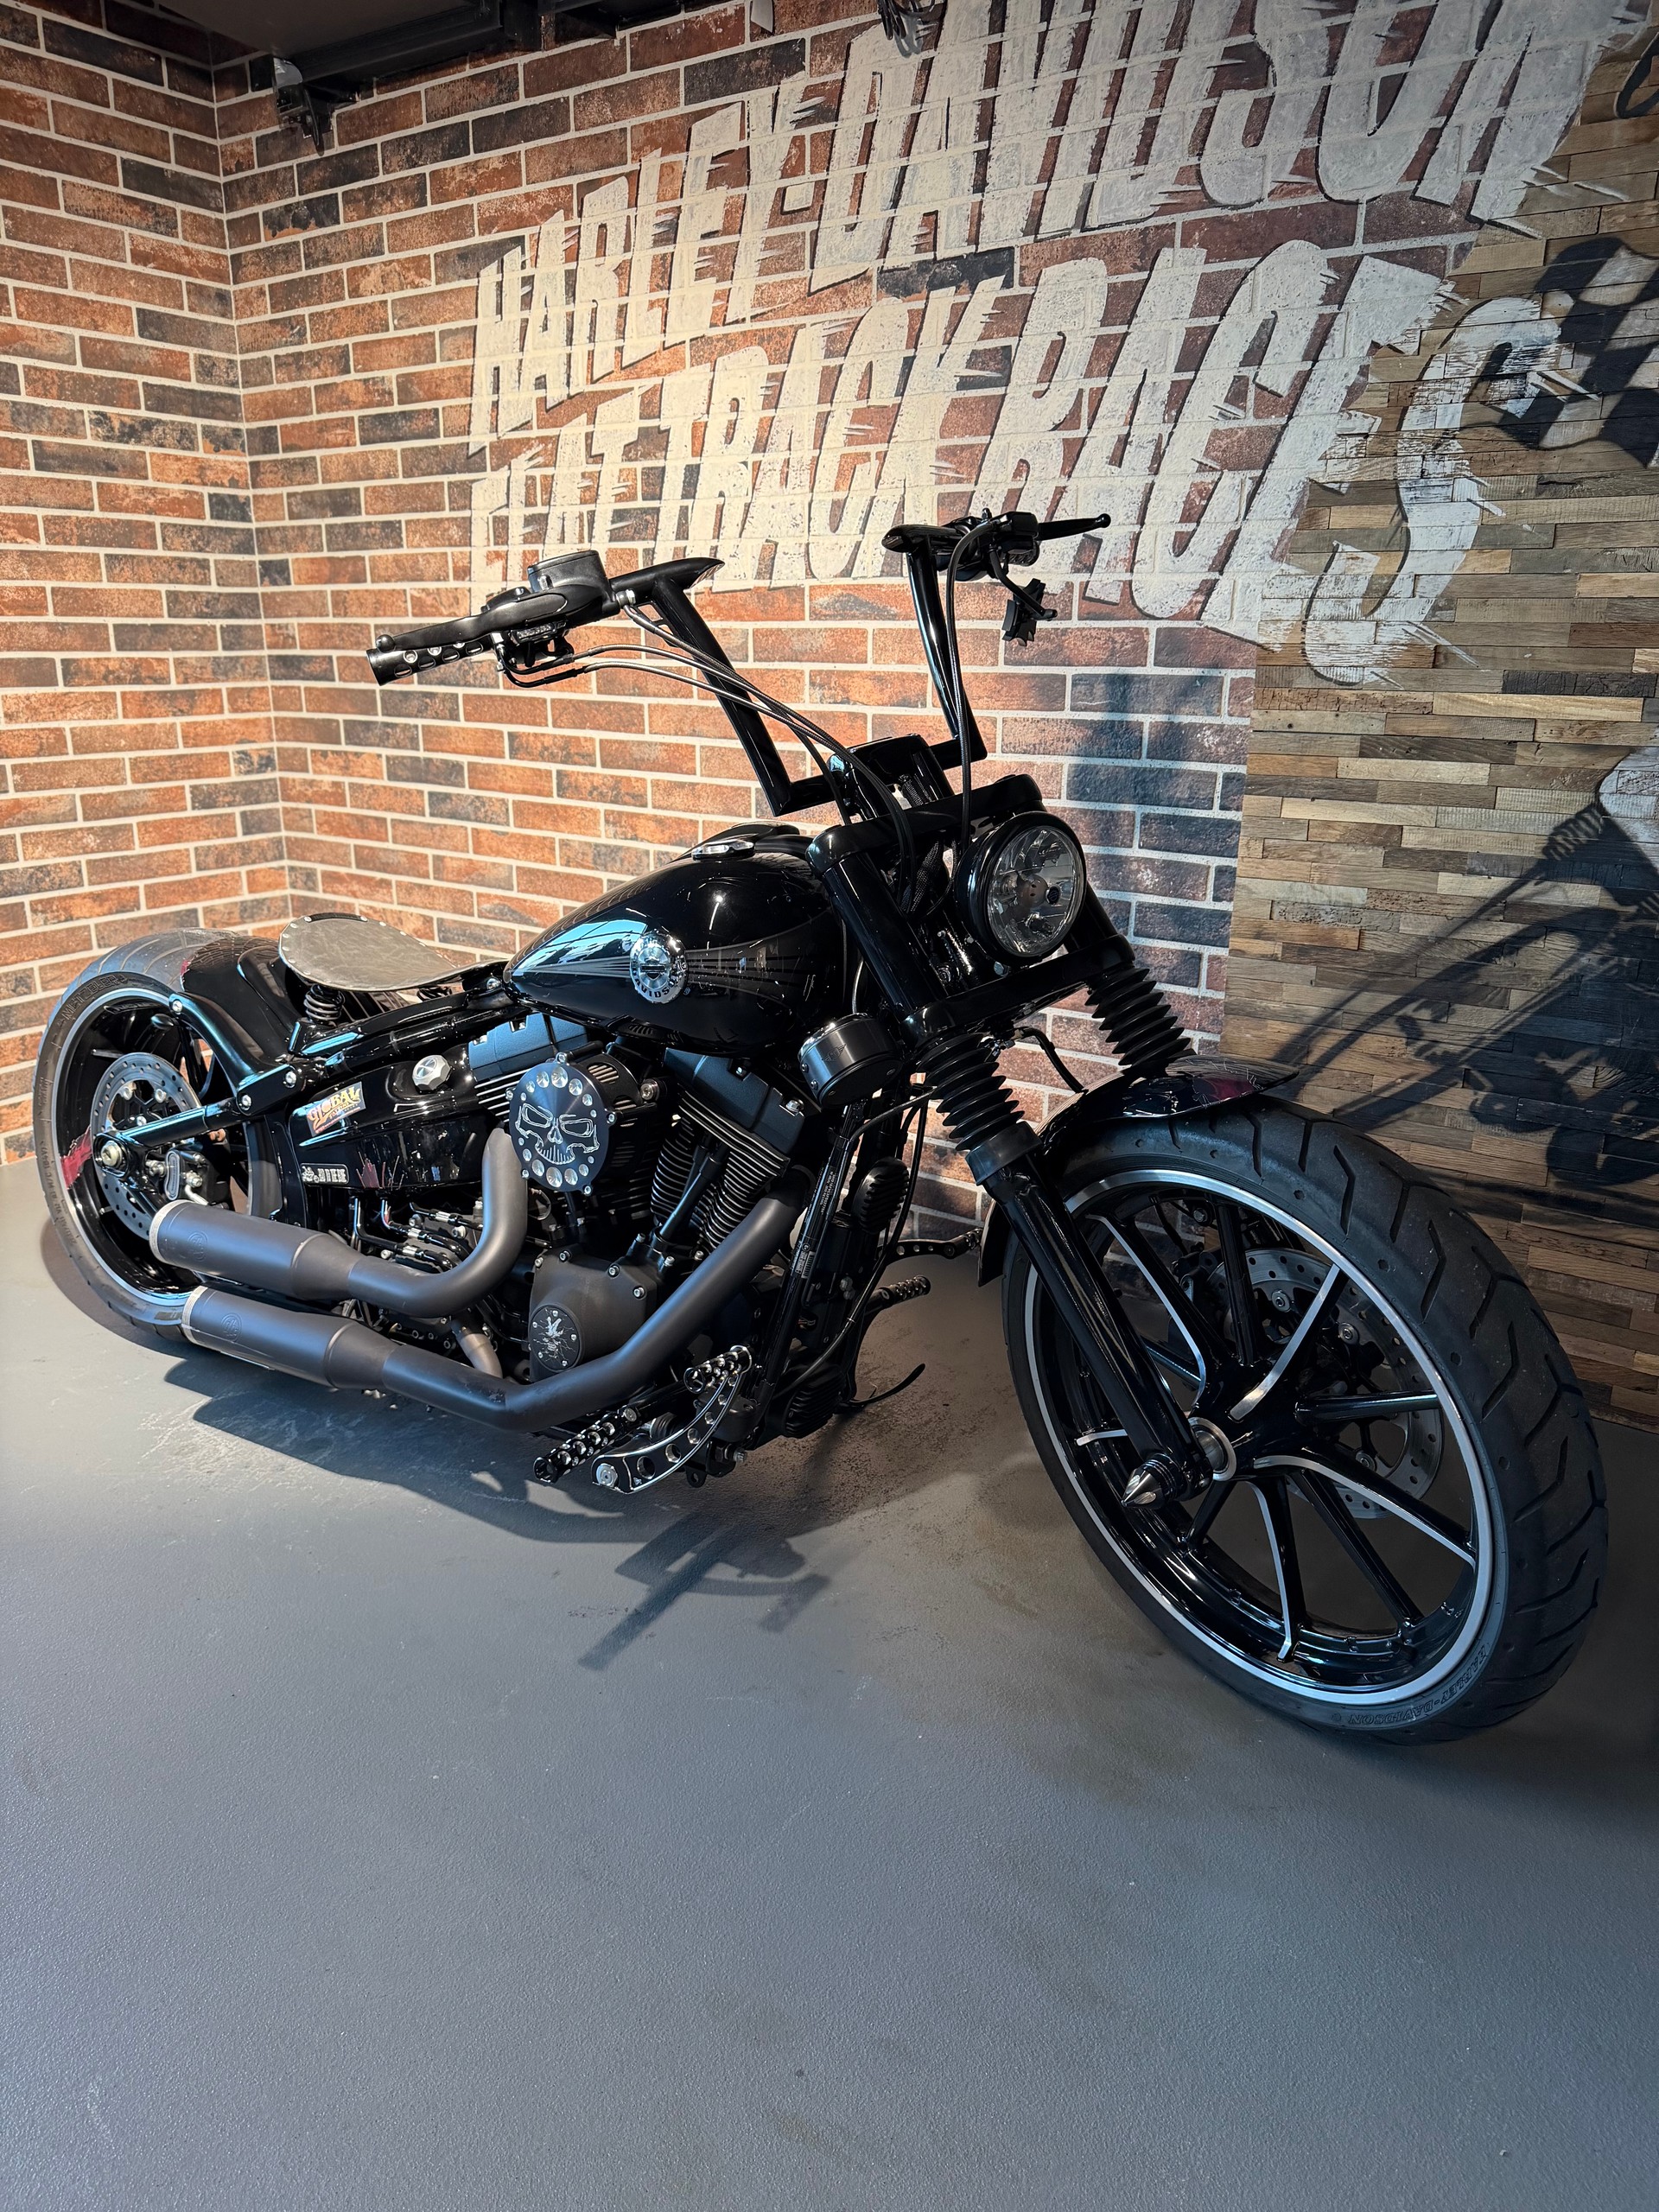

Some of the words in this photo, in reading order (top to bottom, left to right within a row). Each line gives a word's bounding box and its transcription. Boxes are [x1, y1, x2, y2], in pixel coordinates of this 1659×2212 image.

[646, 274, 1007, 594] TRACK
[966, 238, 1566, 686] RACES
[61, 974, 120, 1020] METZELER
[307, 1086, 362, 1130] GLOBAL
[1347, 1644, 1489, 1725] HARLEY-DAVIDSON
